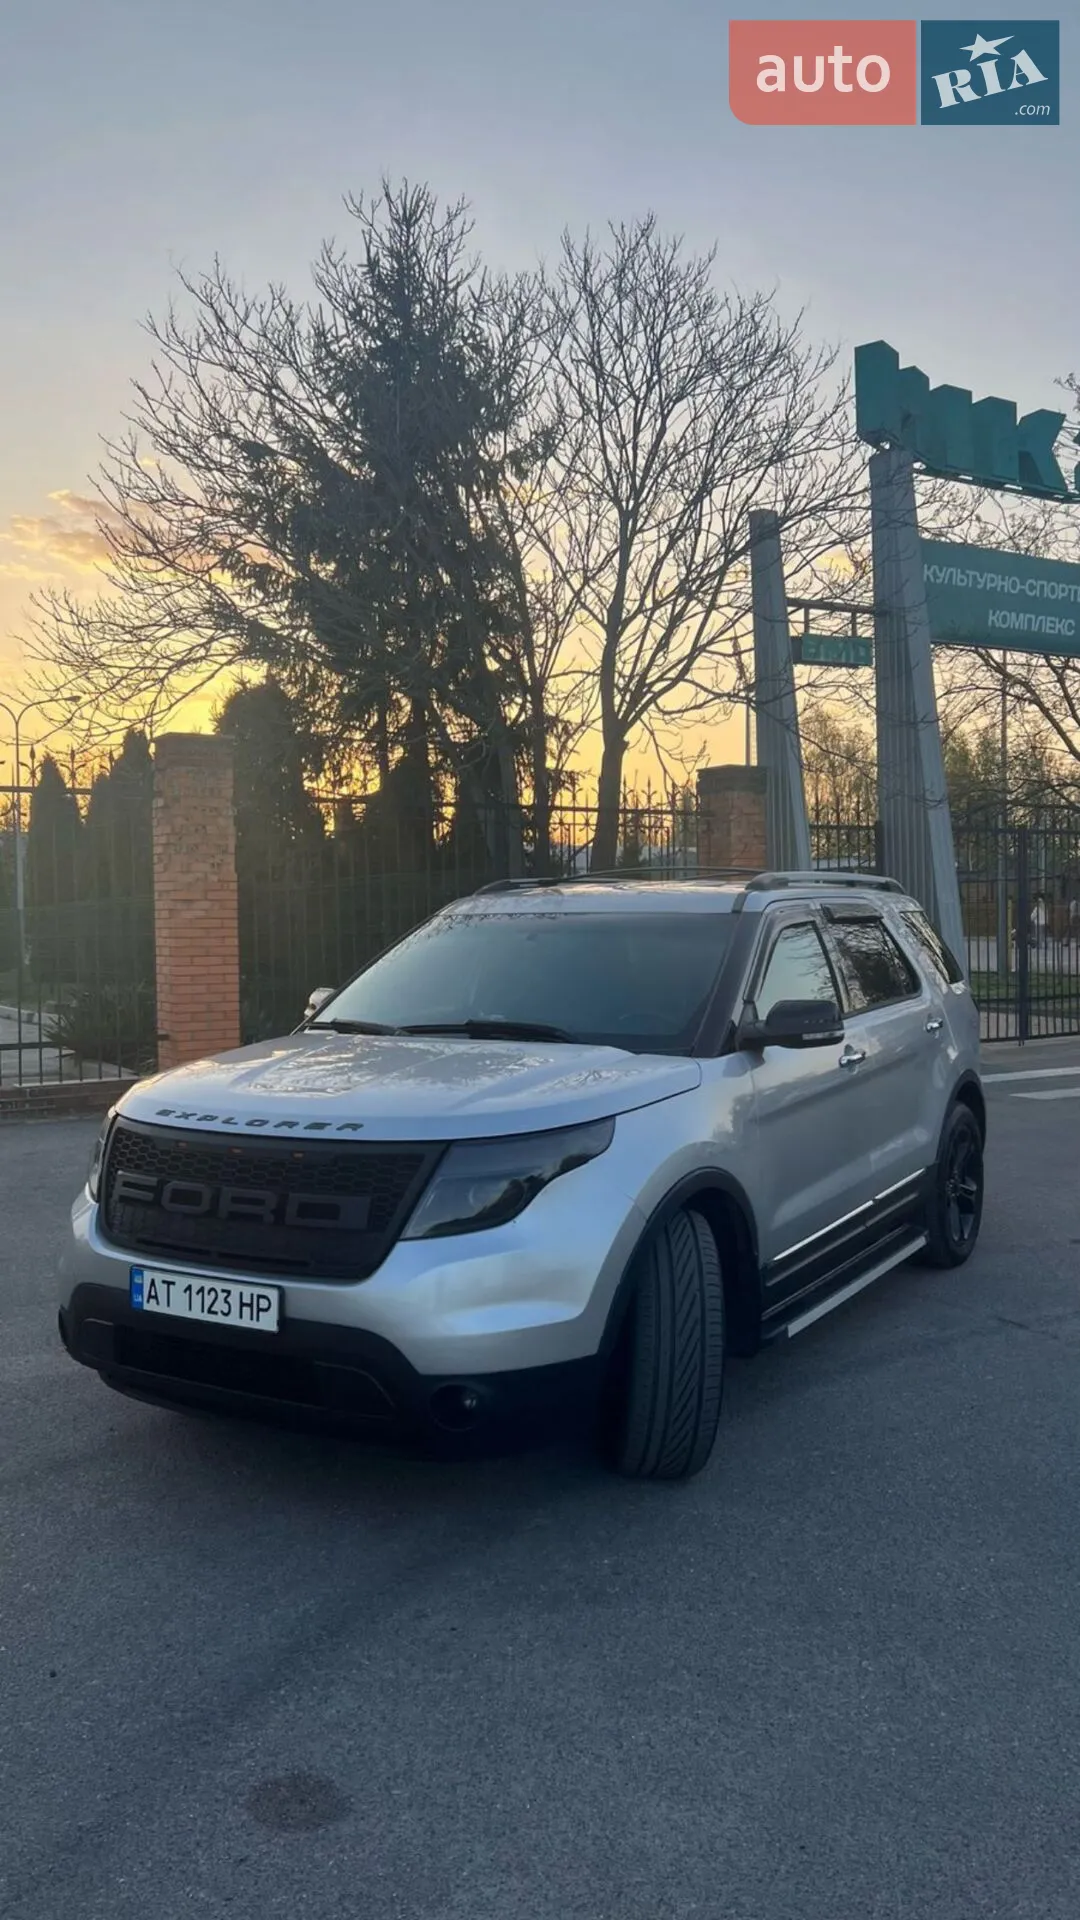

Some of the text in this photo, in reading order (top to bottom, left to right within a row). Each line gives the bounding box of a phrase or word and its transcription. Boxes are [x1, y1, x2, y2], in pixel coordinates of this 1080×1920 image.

[988, 609, 1076, 637] КОМПЛЕКС
[155, 1108, 364, 1132] EXPLORER
[113, 1170, 369, 1228] FORD
[146, 1278, 271, 1322] AT 1123 HP
